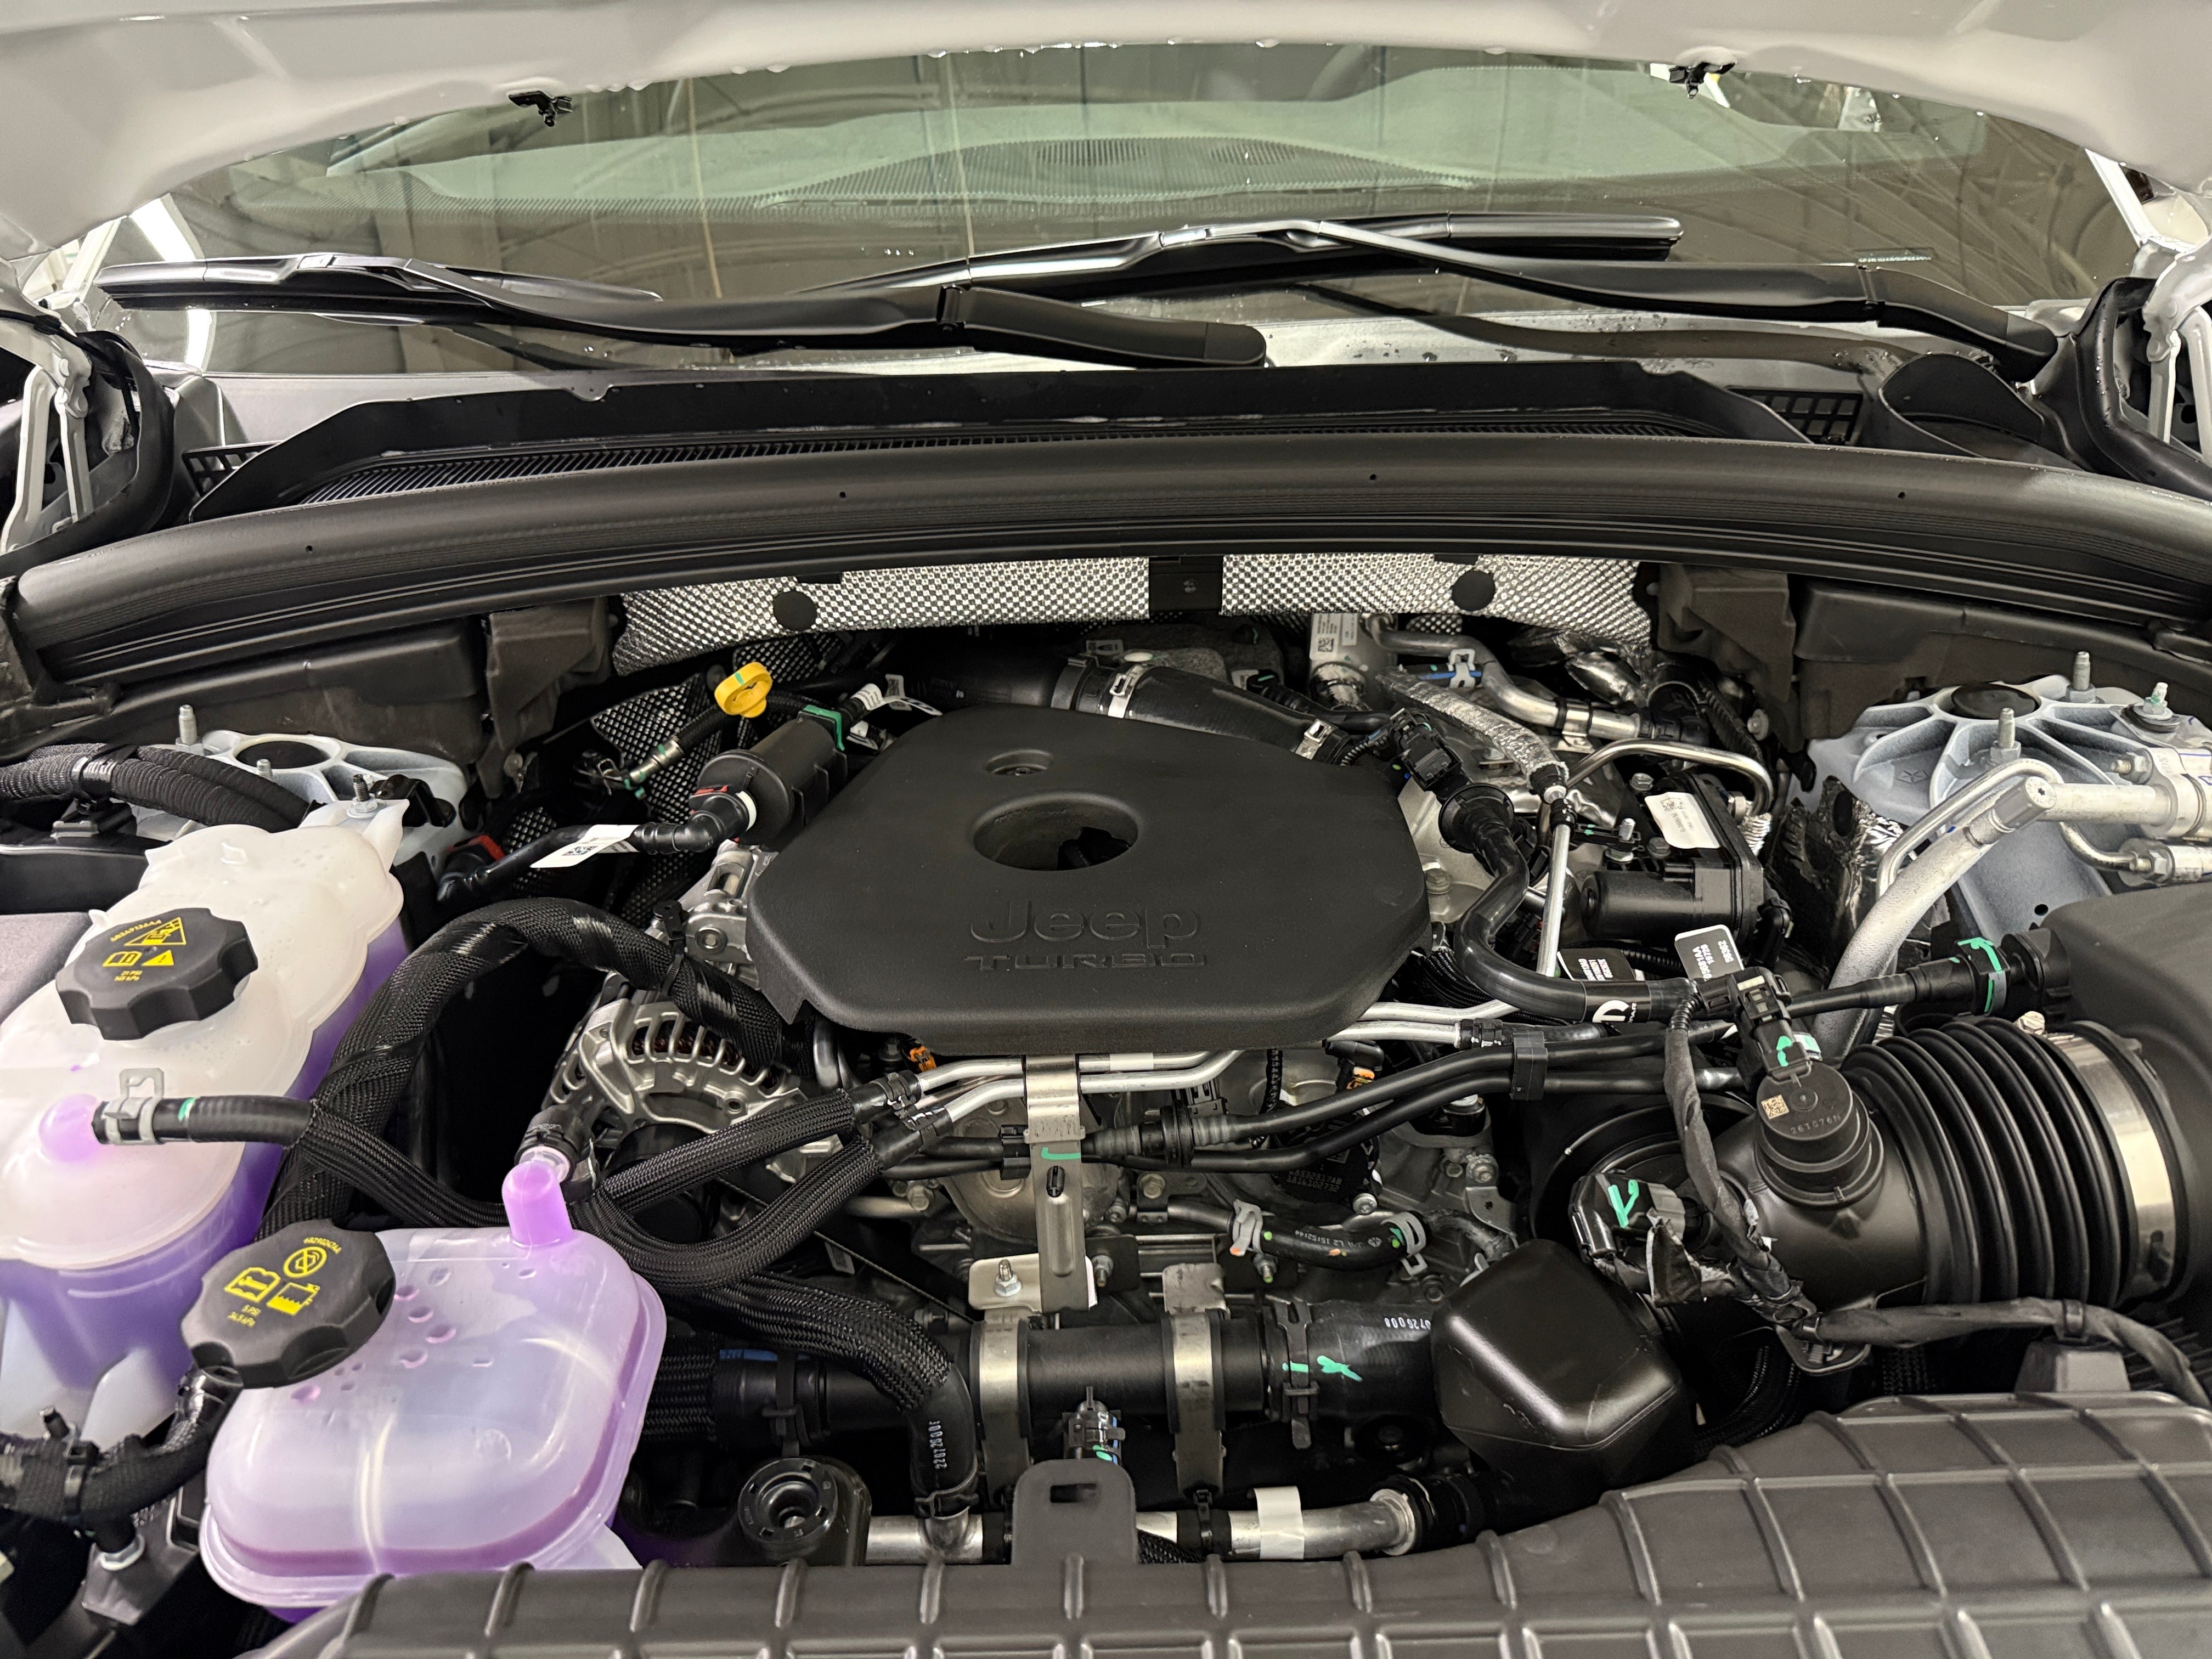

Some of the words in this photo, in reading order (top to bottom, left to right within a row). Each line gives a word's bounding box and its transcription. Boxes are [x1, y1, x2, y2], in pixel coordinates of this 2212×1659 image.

[969, 899, 1200, 949] Jeep
[964, 953, 1205, 971] TURBO
[247, 1306, 262, 1317] PSI
